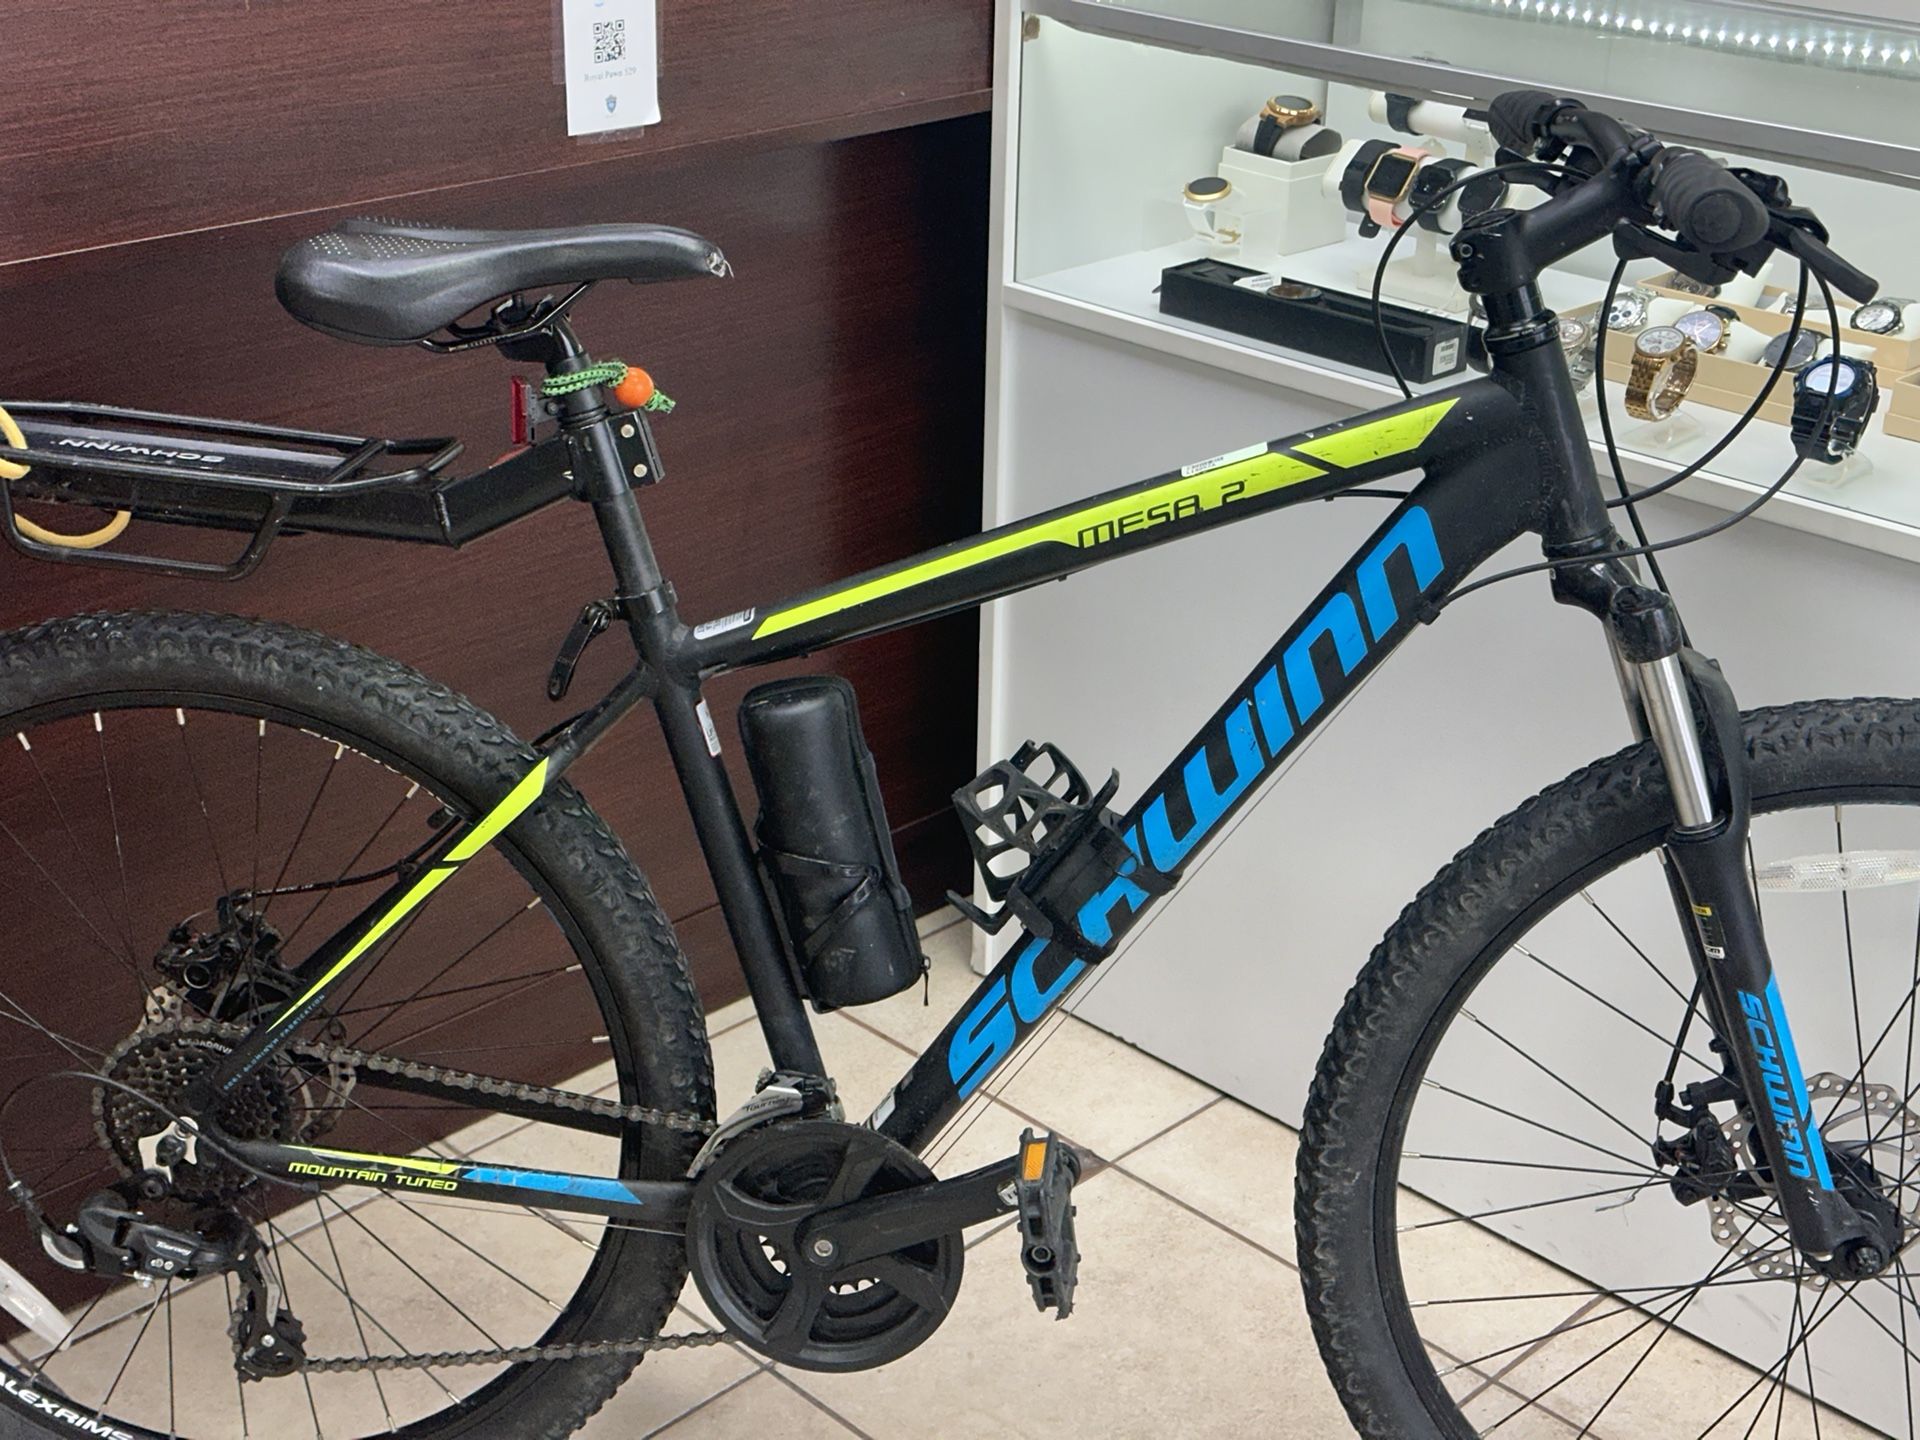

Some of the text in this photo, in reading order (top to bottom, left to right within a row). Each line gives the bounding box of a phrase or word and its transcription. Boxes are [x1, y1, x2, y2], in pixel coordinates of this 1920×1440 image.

[58, 438, 226, 464] SCHWINN
[1078, 480, 1245, 549] MESA 2
[243, 1038, 279, 1073] ALUMINUM
[280, 994, 326, 1038] FABRICATION
[1737, 990, 1812, 1179] SCHWINN
[288, 1161, 458, 1192] MOUNTAIN TUNED
